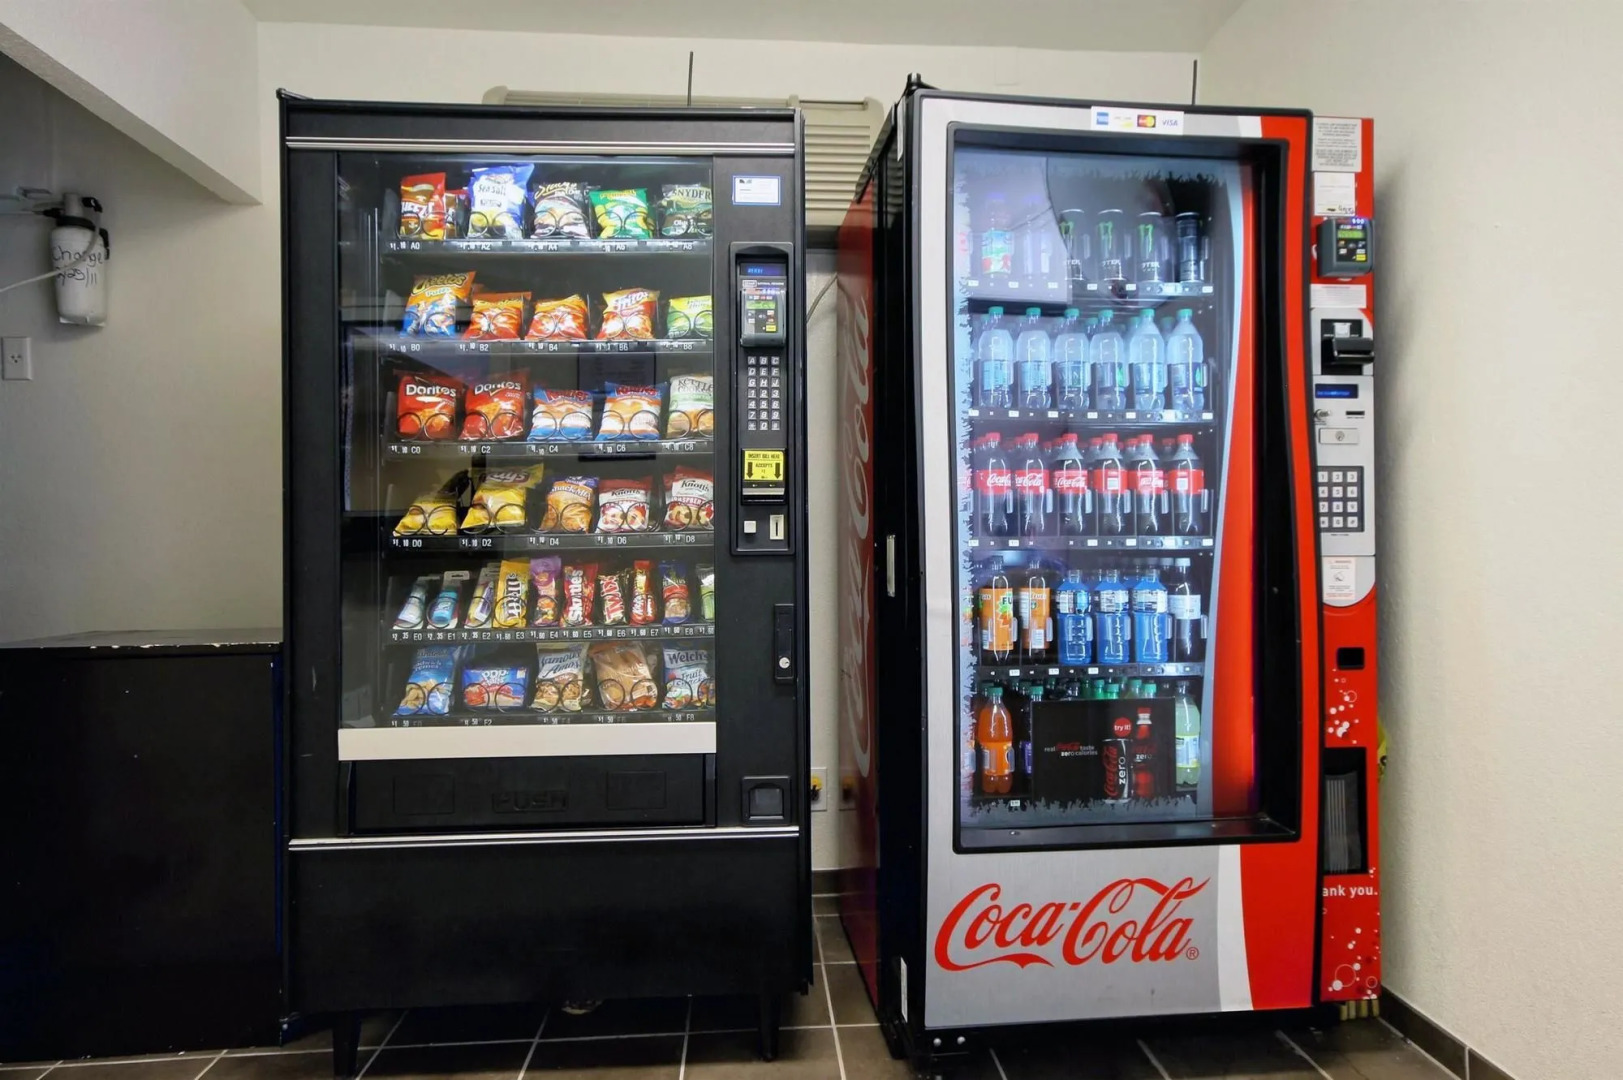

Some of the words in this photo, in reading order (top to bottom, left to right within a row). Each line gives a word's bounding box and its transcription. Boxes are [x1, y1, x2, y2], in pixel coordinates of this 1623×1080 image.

[1162, 119, 1178, 127] VISA
[52, 245, 103, 268] Chage
[412, 273, 467, 295] Cheetos
[405, 384, 457, 398] Doritos
[474, 381, 522, 395] Doritos
[481, 445, 491, 453] C2
[549, 445, 559, 453] C4
[600, 574, 625, 622] TWIX
[448, 632, 456, 640] E1
[482, 632, 491, 640] E2
[516, 631, 525, 639] E3
[550, 631, 560, 639] E4
[583, 629, 592, 638] E5
[617, 629, 626, 637] E6
[651, 628, 659, 636] E7
[685, 627, 694, 636] E8
[413, 633, 423, 641] E0
[667, 650, 708, 665] Welch's
[1113, 724, 1124, 732] try
[1124, 723, 1132, 731] it!
[1118, 756, 1126, 785] zero
[1322, 884, 1346, 897] ank
[1349, 885, 1378, 899] you.
[934, 877, 1211, 972] Coca-Cola
